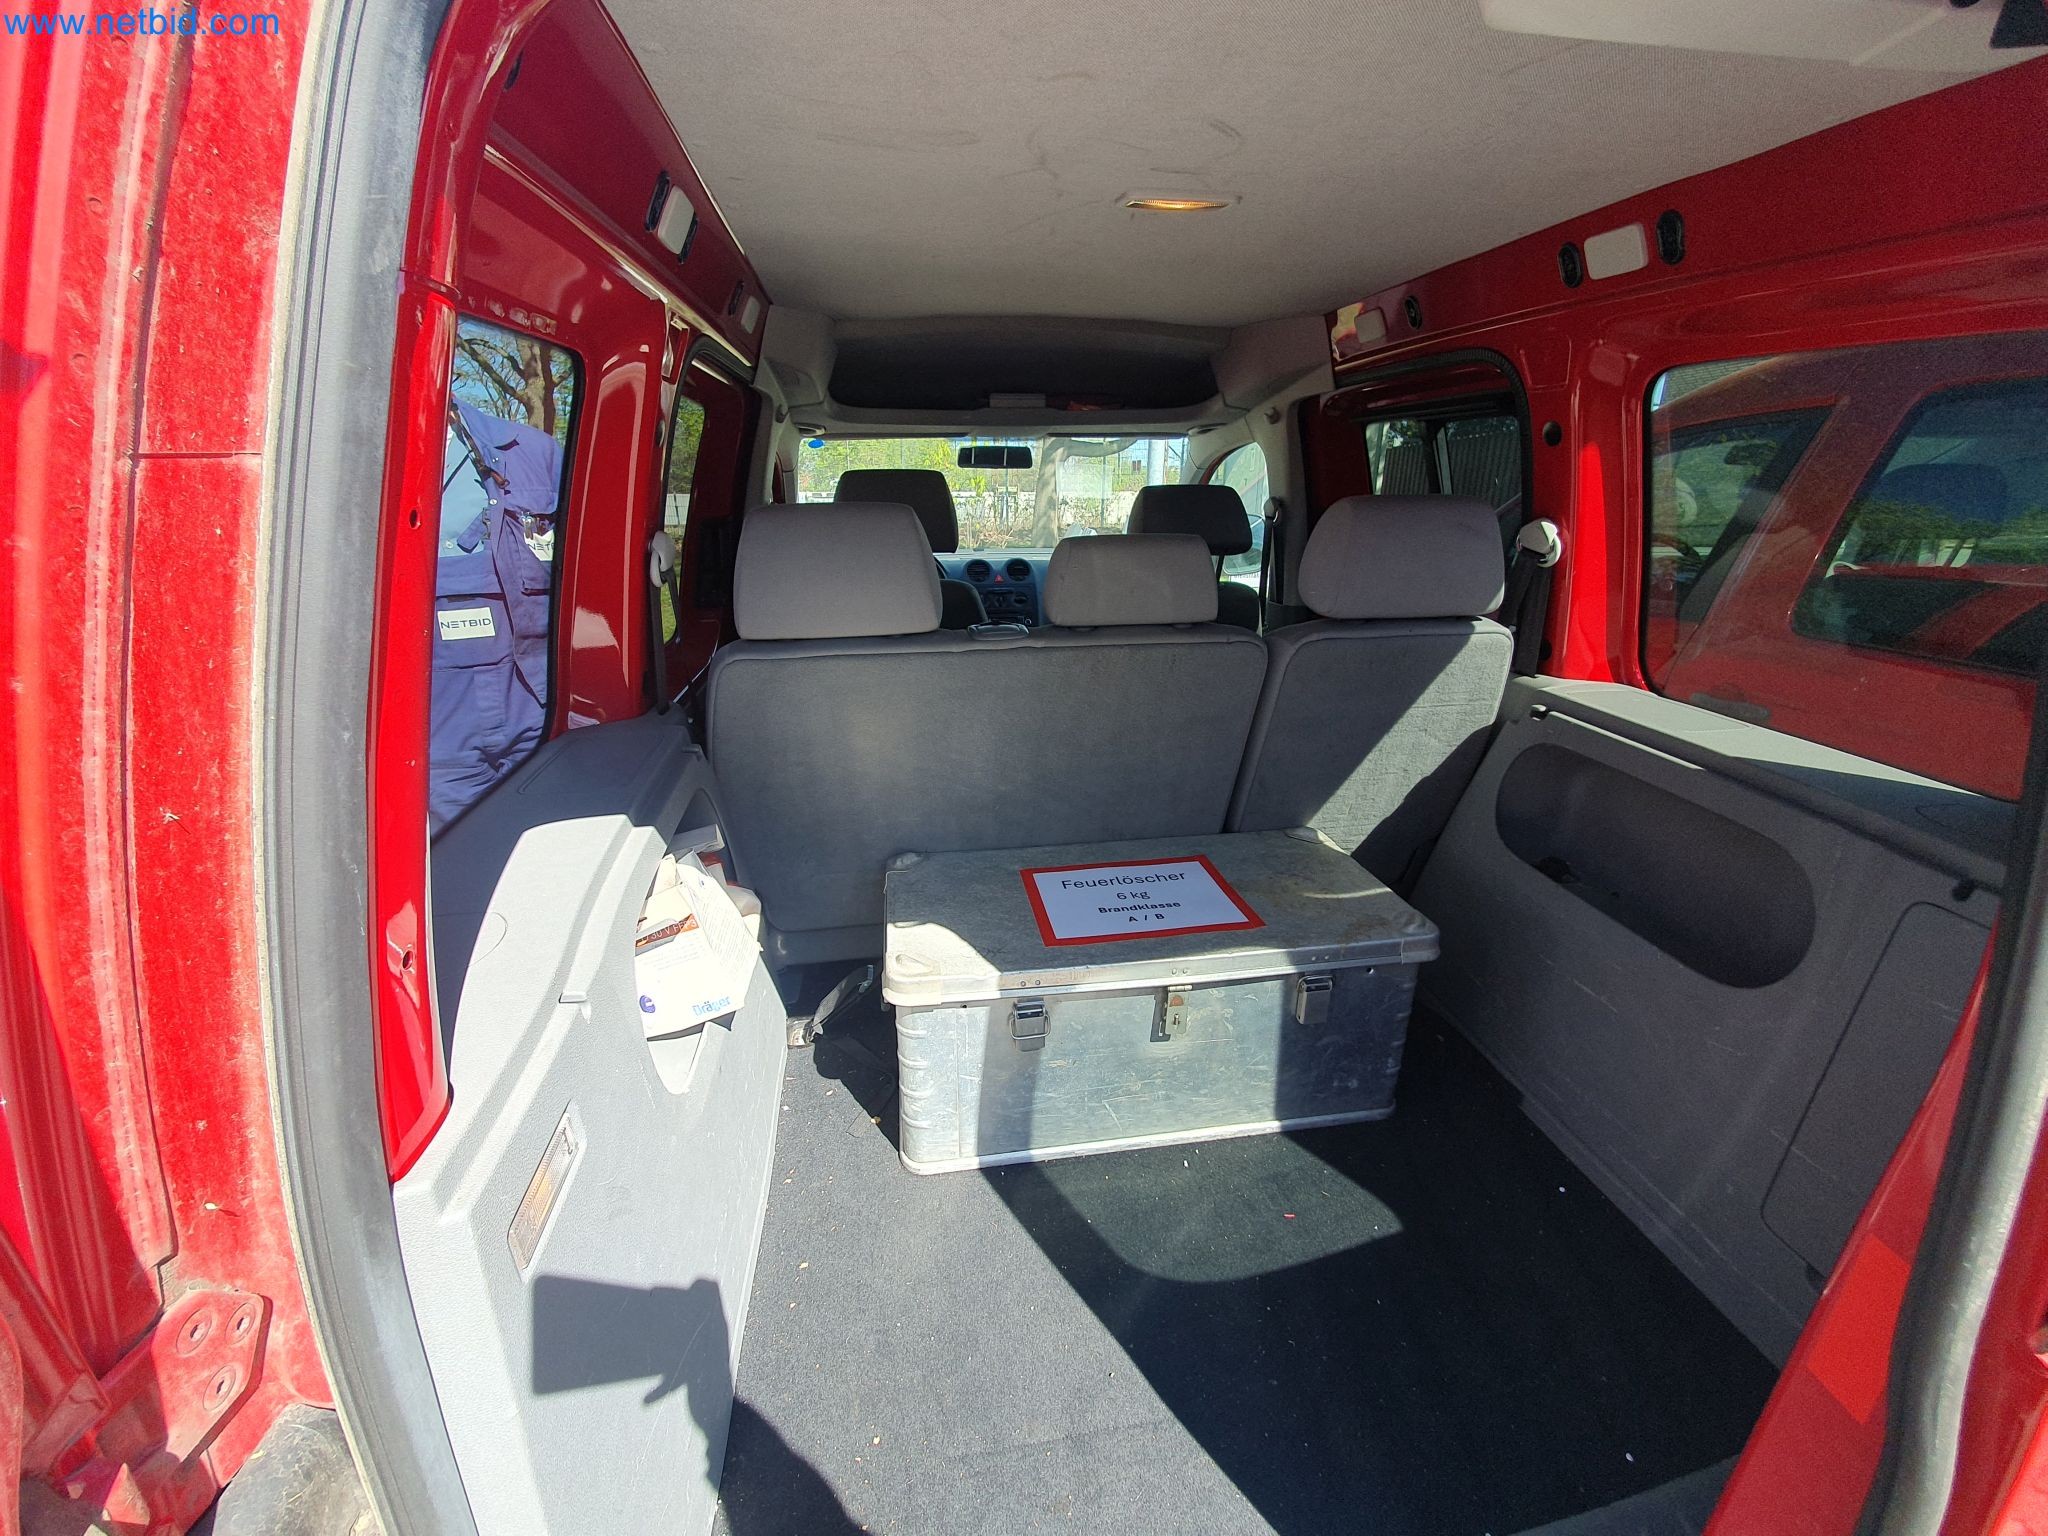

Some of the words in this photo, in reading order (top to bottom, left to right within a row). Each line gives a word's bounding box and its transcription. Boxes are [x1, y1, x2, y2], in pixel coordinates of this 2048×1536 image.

[440, 618, 492, 629] NETBID
[1061, 872, 1186, 890] Feuerlöscher
[1116, 892, 1127, 900] 6
[1130, 891, 1151, 900] kg
[1098, 902, 1181, 914] Brandklasse
[1128, 915, 1138, 923] A
[692, 995, 731, 1017] Dräger
